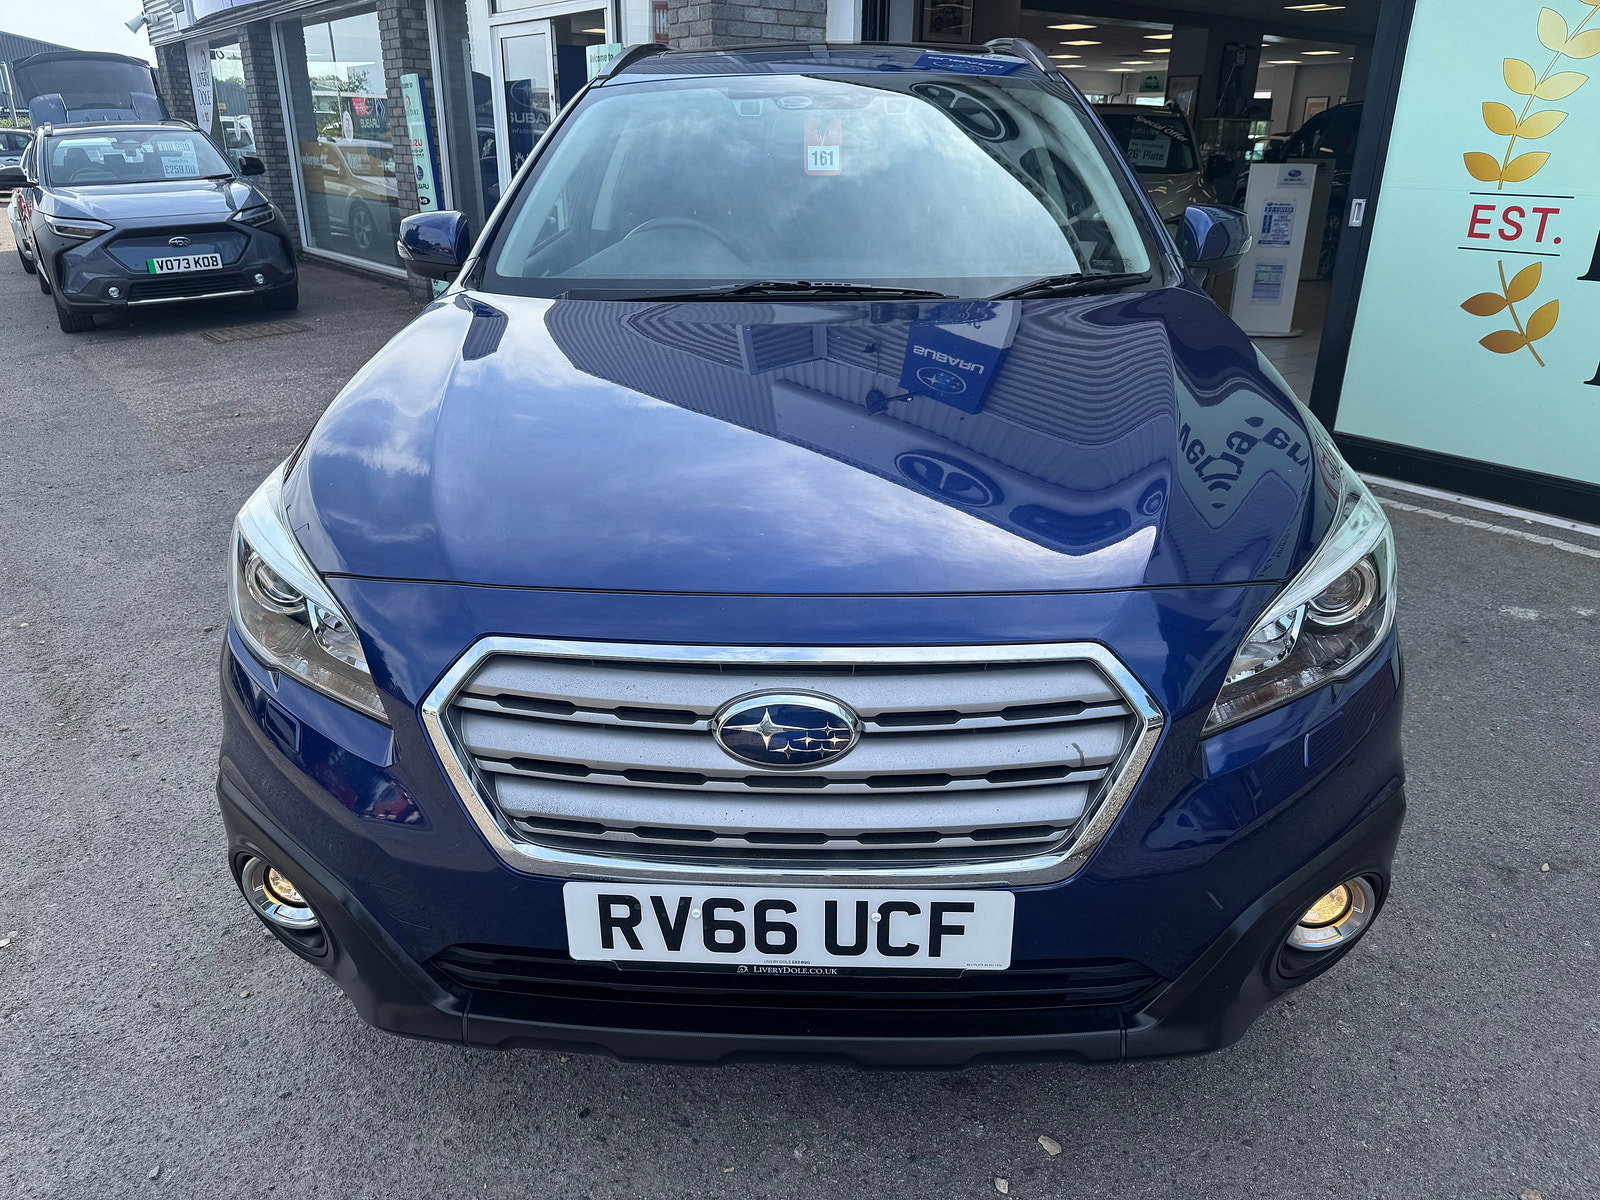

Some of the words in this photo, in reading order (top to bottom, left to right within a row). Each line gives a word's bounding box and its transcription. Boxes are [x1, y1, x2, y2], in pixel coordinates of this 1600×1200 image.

[510, 112, 551, 124] SUBA
[1133, 115, 1166, 130] Special
[1164, 127, 1188, 142] Offer
[811, 150, 834, 166] 161
[1143, 150, 1165, 161] Plate
[1467, 204, 1562, 245] EST.
[193, 255, 219, 268] KOB
[597, 893, 798, 955] RV66
[824, 899, 975, 958] UCF
